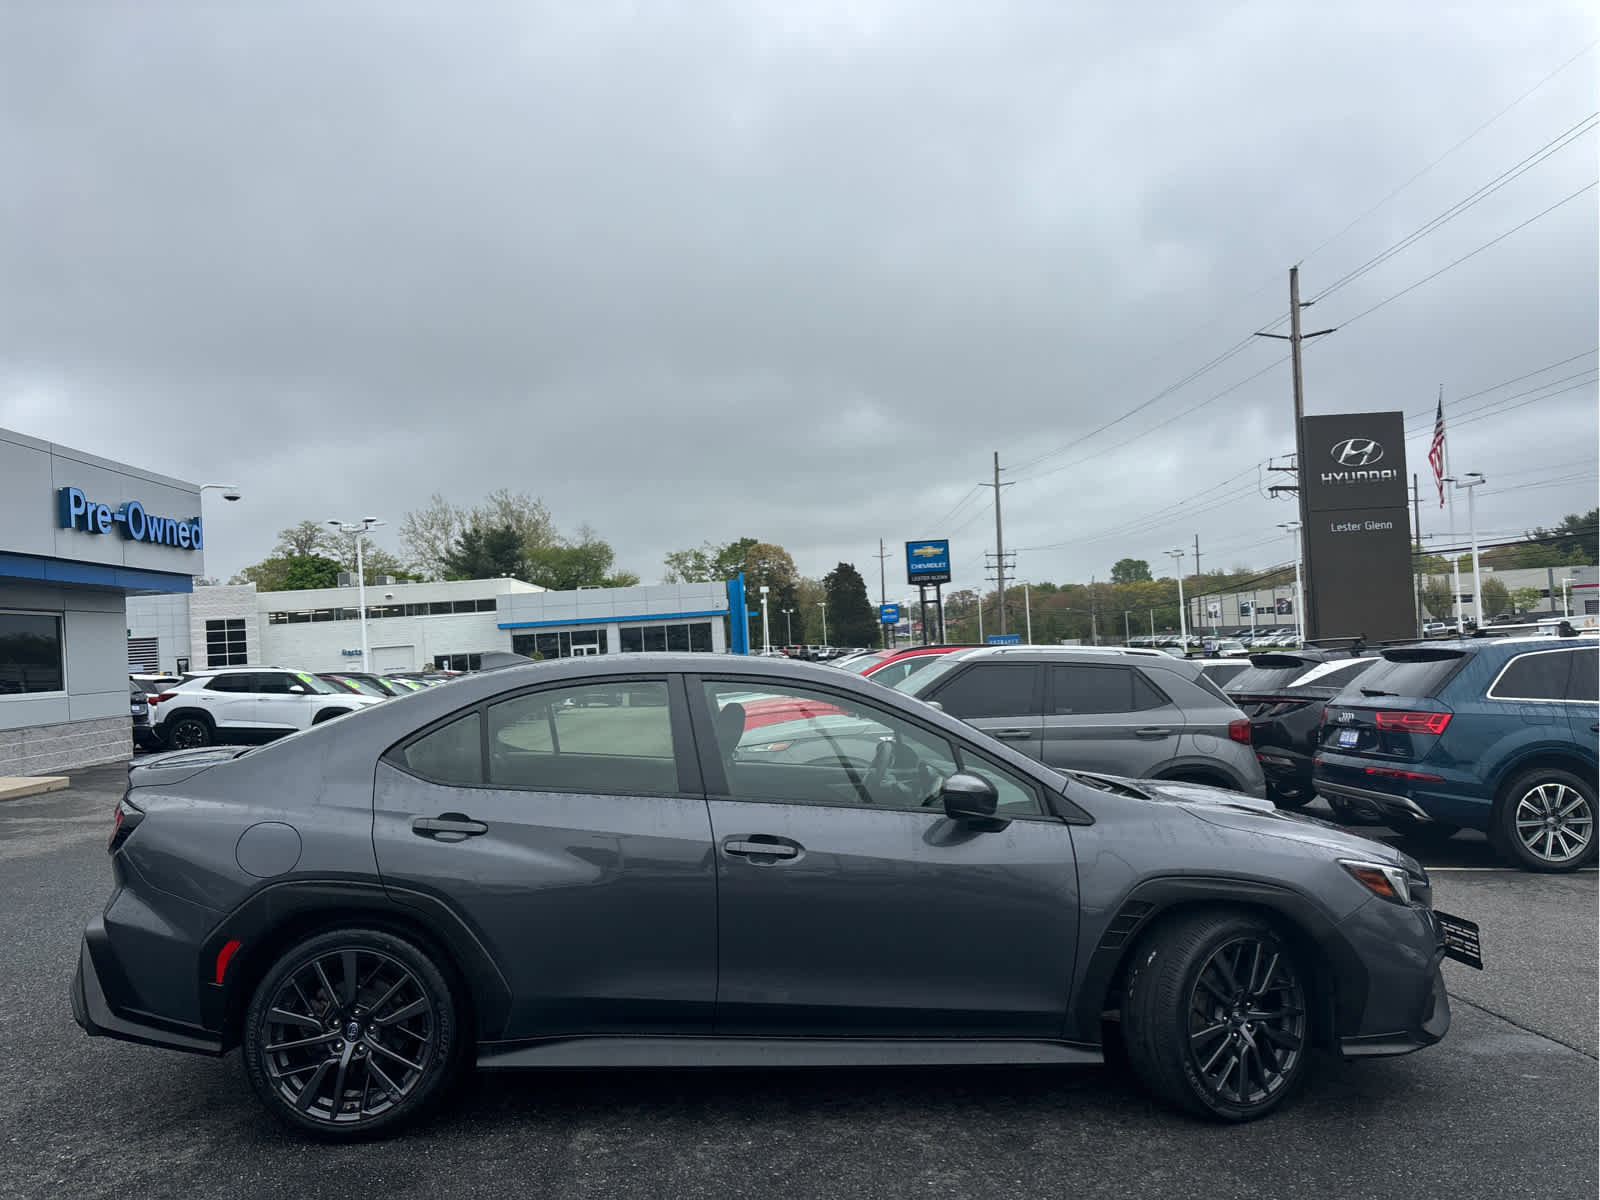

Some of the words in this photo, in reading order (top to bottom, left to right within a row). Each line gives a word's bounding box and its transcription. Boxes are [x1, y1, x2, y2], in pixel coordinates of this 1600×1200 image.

[1321, 469, 1397, 485] HYUNDAI
[60, 486, 203, 551] Pre-Owned
[1330, 522, 1361, 532] Lester
[1364, 521, 1393, 530] Glenn
